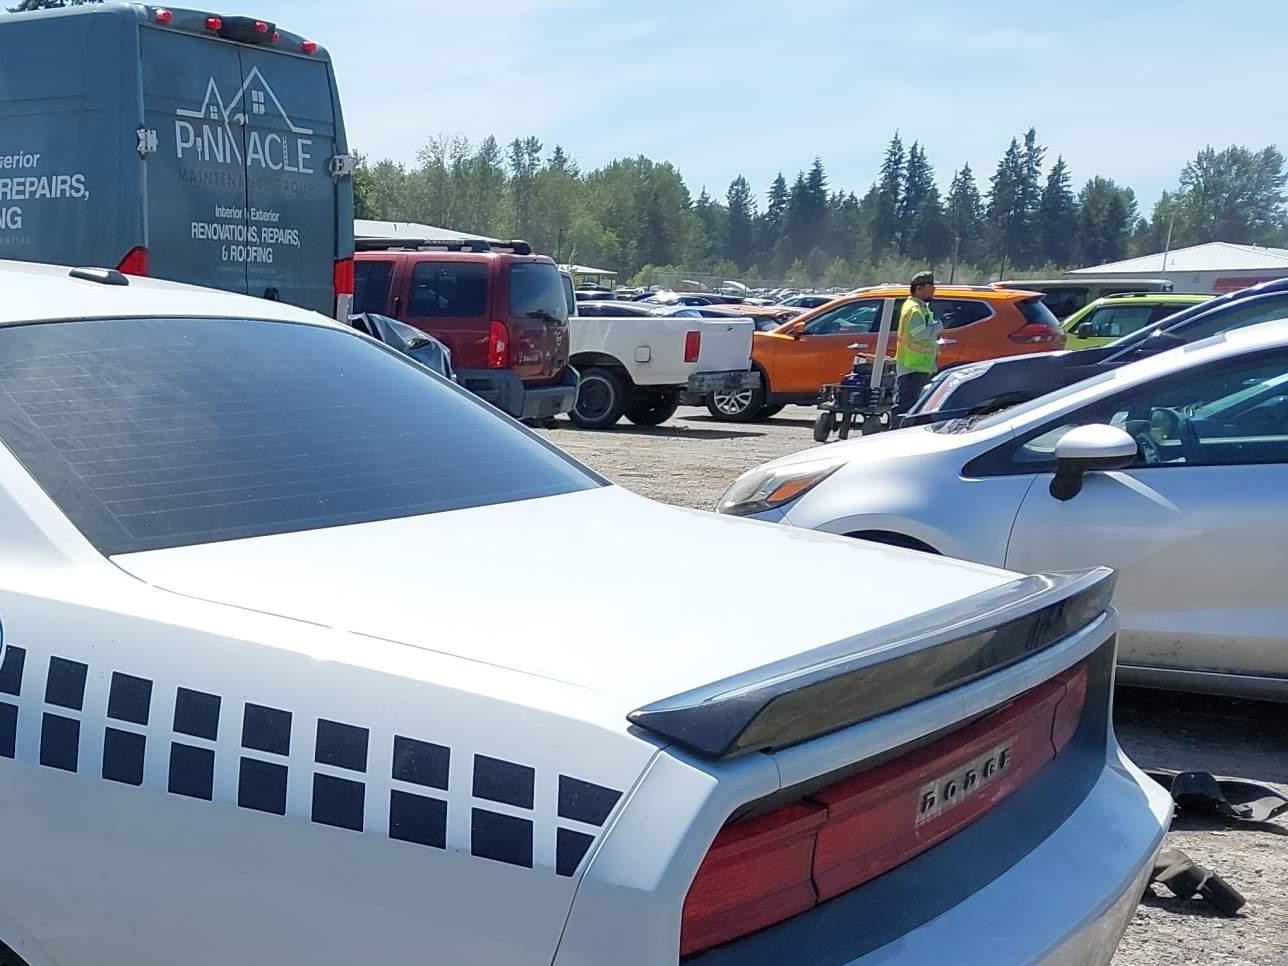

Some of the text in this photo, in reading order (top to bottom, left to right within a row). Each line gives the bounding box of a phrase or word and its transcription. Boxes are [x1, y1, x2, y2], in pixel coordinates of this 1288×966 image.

[175, 120, 314, 174] PINNACLE
[215, 203, 242, 219] Interior
[250, 208, 279, 222] Exterior
[191, 222, 300, 248] RENOVATIONS, REPAIRS,
[222, 245, 273, 264] & ROOFING
[920, 746, 1012, 816] DODGE
